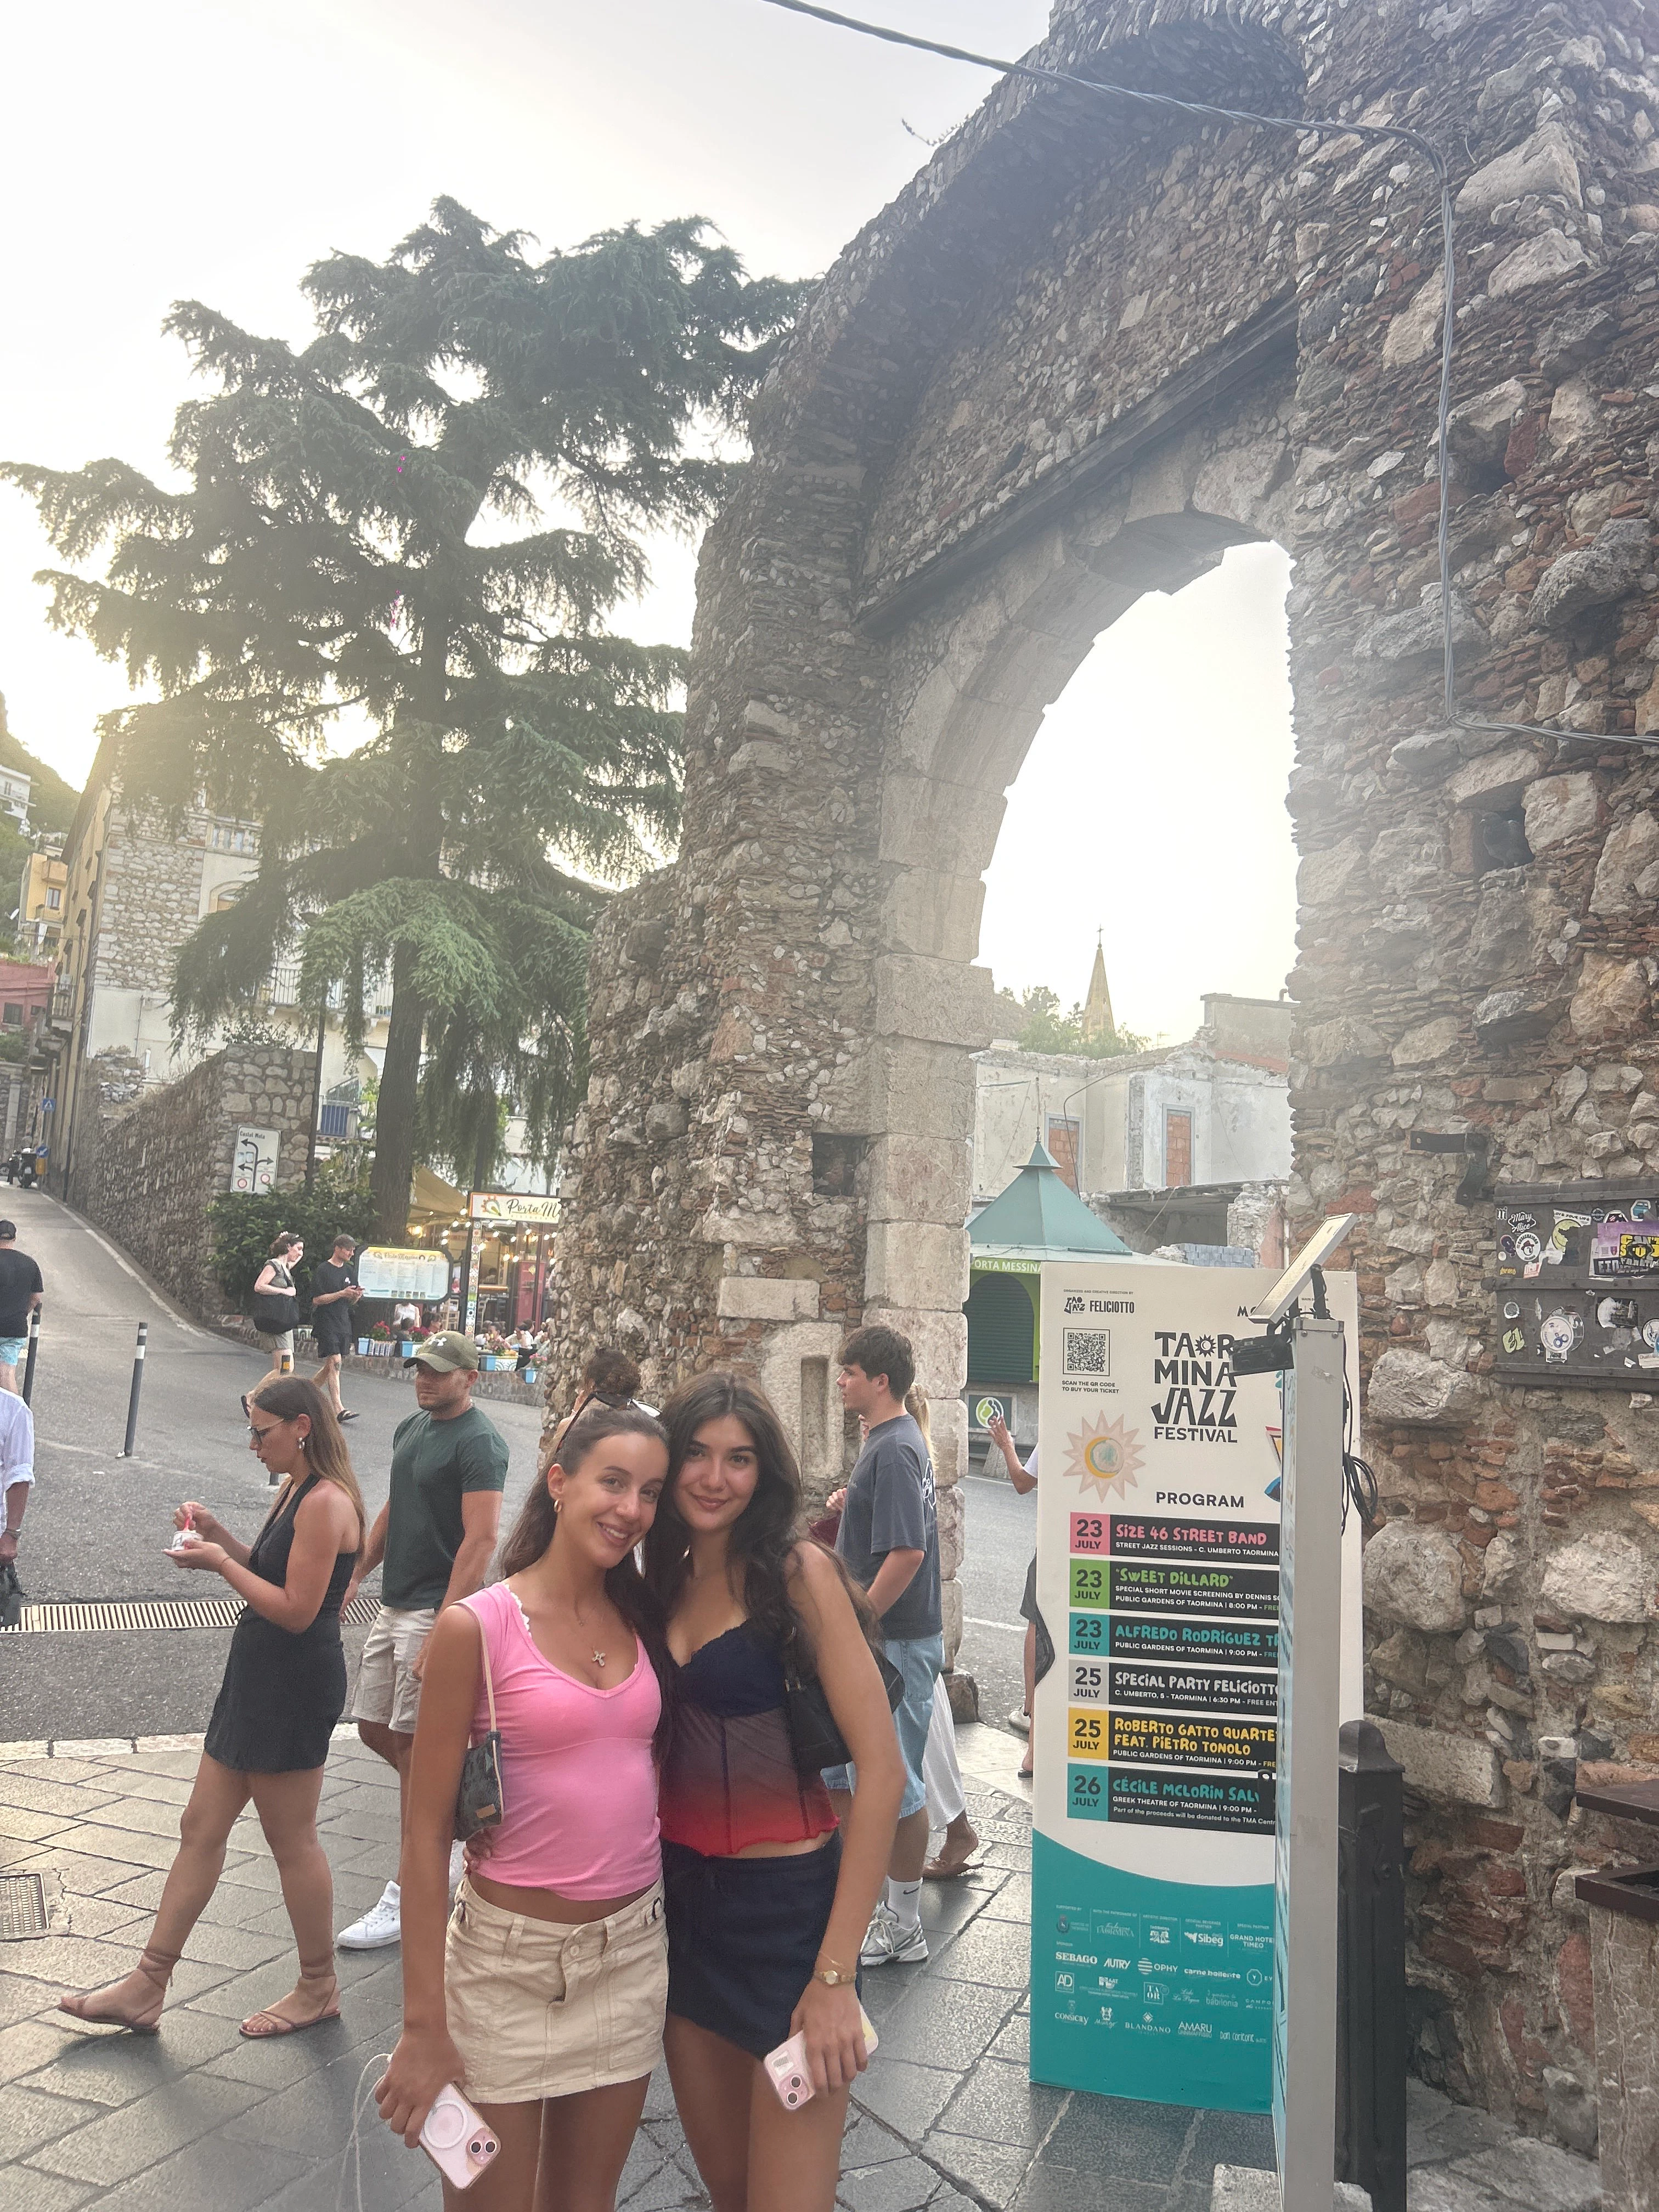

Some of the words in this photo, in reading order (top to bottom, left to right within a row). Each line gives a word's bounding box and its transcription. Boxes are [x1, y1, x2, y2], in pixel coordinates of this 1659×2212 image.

[506, 1199, 540, 1214] Porta
[1511, 1211, 1532, 1223] Mary
[1512, 1222, 1531, 1233] Alice
[1090, 1300, 1135, 1313] FELICIOTTO
[1154, 1359, 1237, 1387] MINA
[1151, 1387, 1238, 1427] JAZZ
[1154, 1426, 1238, 1443] FESTIVAL
[1156, 1491, 1244, 1508] PROGRAM
[1076, 1519, 1103, 1538] 23
[1150, 1526, 1169, 1541] 46
[1173, 1527, 1224, 1543] STREET
[1228, 1531, 1267, 1545] BAND
[1075, 1540, 1101, 1550] JULY
[1076, 1568, 1102, 1588] 23
[1074, 1590, 1101, 1600] JULY
[1193, 1590, 1233, 1599] SCREENING
[1187, 1600, 1223, 1608] TAORMINA
[1075, 1618, 1102, 1638] 23
[1115, 1624, 1178, 1641] ALFREDO
[1074, 1640, 1101, 1650] JULY
[1187, 1646, 1223, 1655] TAORMINA
[1075, 1667, 1102, 1686] 25
[1169, 1675, 1210, 1691] PARTY
[1073, 1689, 1101, 1698] JULY
[1124, 1690, 1159, 1699] UMBERTO,
[1171, 1694, 1207, 1702] TAORMINA
[1075, 1719, 1101, 1738] 25
[1114, 1717, 1174, 1735] ROBERTO
[1178, 1724, 1219, 1739] GATTO
[1223, 1726, 1277, 1742] QUARTE
[1073, 1740, 1099, 1750] JULY
[1114, 1734, 1148, 1748] FEAT.
[1202, 1741, 1251, 1755] TONOLO
[1139, 1752, 1173, 1760] GARDENS
[1185, 1755, 1222, 1764] TAORMINA
[1074, 1775, 1101, 1795] 26
[1072, 1797, 1099, 1807] JULY
[1137, 1798, 1168, 1807] THEATRE
[1180, 1802, 1217, 1811] TAORMINA
[1198, 1933, 1224, 1947] Sibeg
[1056, 1951, 1097, 1965] SEBAGO
[1104, 1958, 1131, 1970] AUTRY
[1154, 1963, 1178, 1972] OPHY
[1057, 1974, 1073, 1987] AD
[1206, 1997, 1238, 2008] babilonia
[1125, 2022, 1171, 2034] BLANDANO
[1178, 2021, 1212, 2033] AMARU
